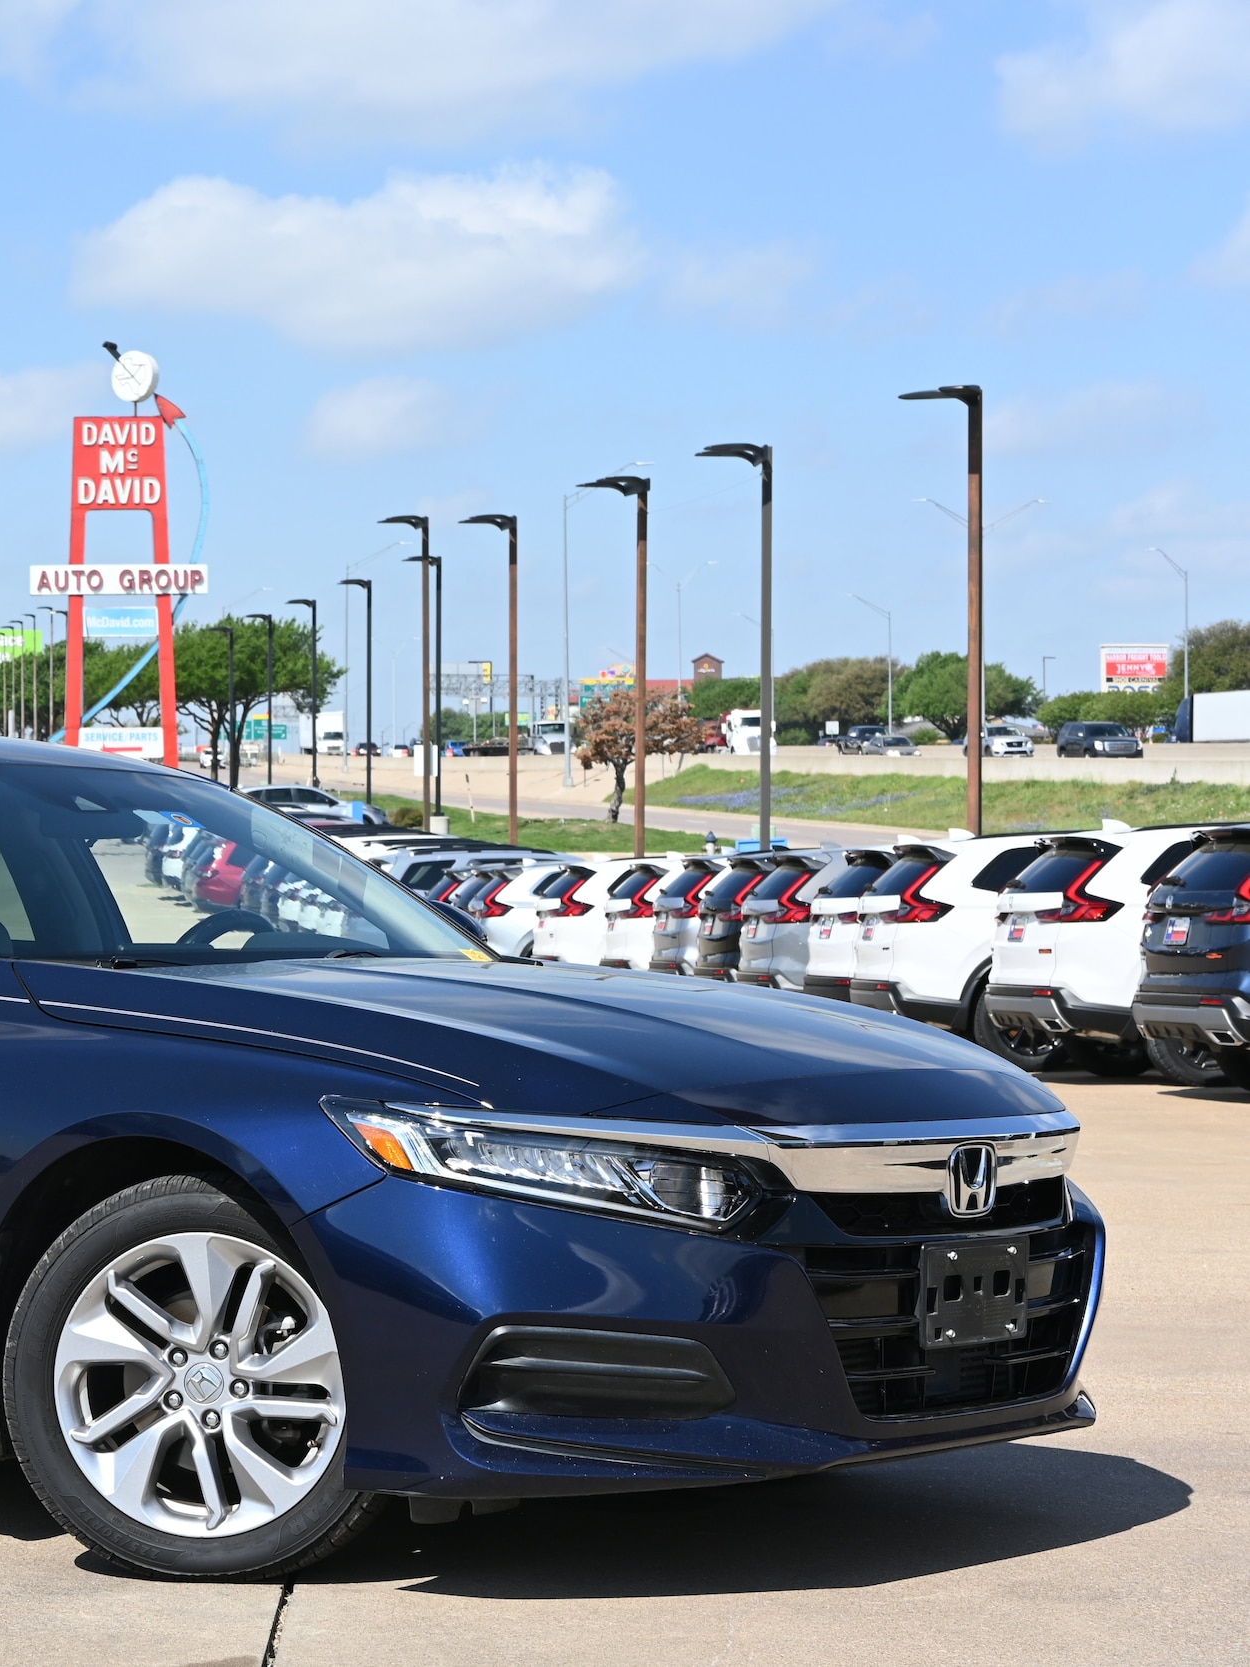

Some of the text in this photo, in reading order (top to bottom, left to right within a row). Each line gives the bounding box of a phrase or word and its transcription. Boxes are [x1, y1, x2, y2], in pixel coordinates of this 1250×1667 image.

[82, 422, 156, 446] DAVID
[77, 477, 161, 505] DAVID
[37, 569, 204, 592] AUTO GROUP
[86, 616, 155, 628] McDavid.com
